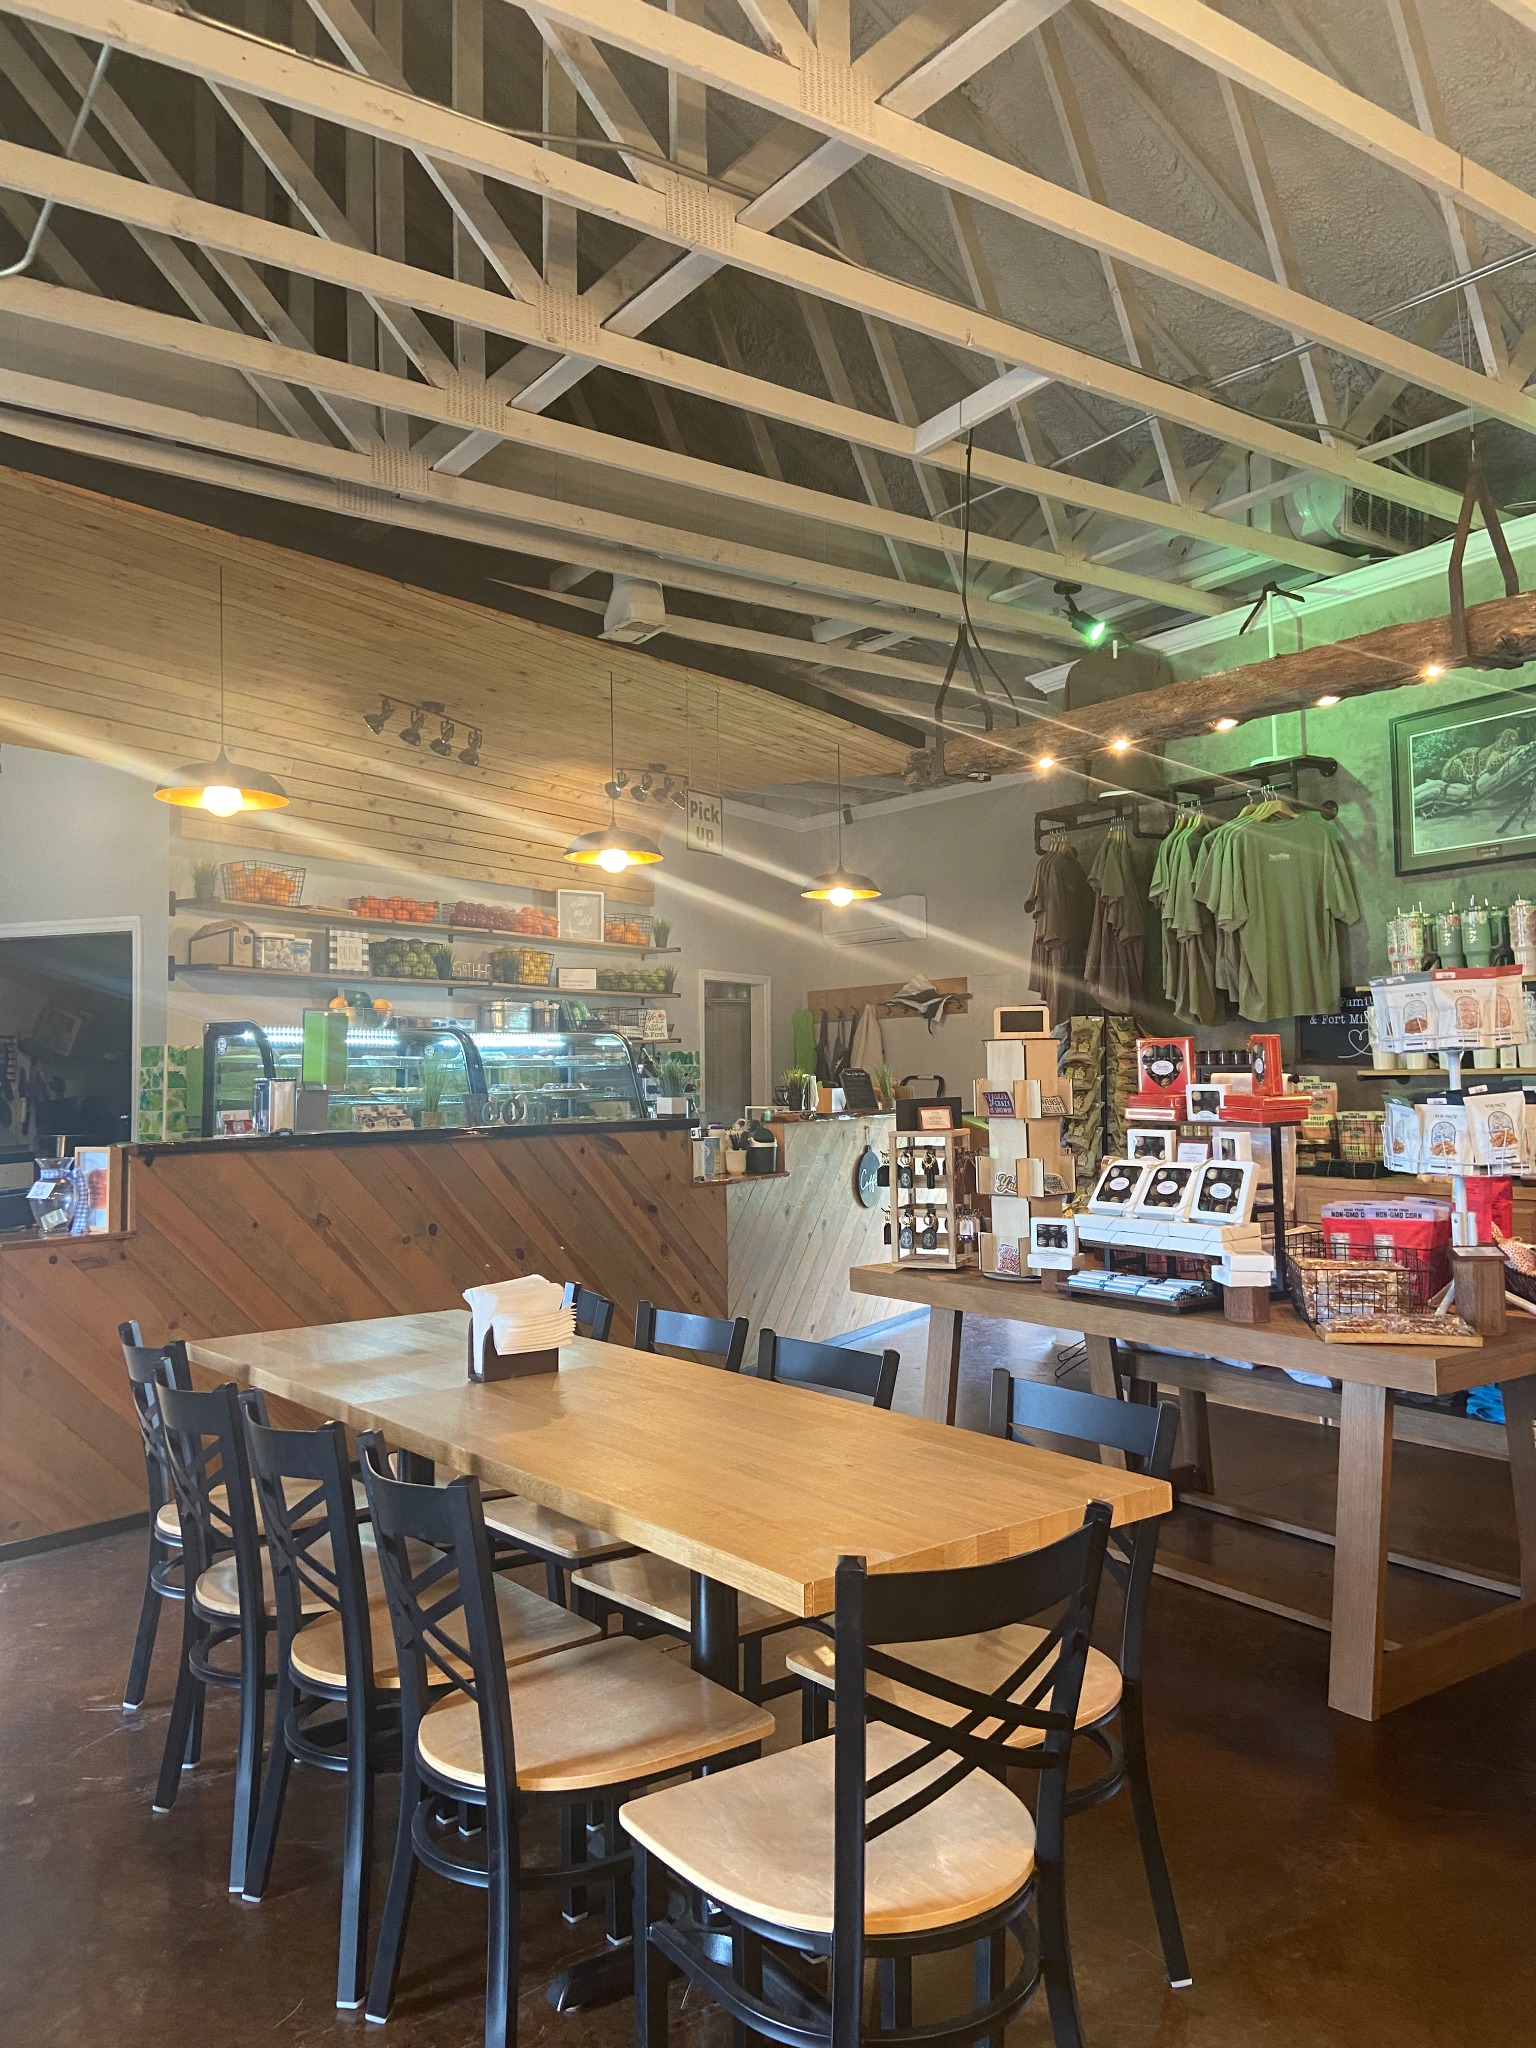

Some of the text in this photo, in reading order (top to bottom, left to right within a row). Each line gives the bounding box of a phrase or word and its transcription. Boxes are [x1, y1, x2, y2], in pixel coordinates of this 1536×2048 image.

[690, 800, 720, 824] Pick
[696, 827, 715, 848] up
[452, 961, 492, 979] GATHER
[1309, 1013, 1369, 1025] & Fort Mil
[860, 1168, 878, 1194] Coff
[1331, 1211, 1360, 1219] NON-GMO
[1375, 1211, 1403, 1219] NON-GMO
[1404, 1211, 1422, 1219] CORN
